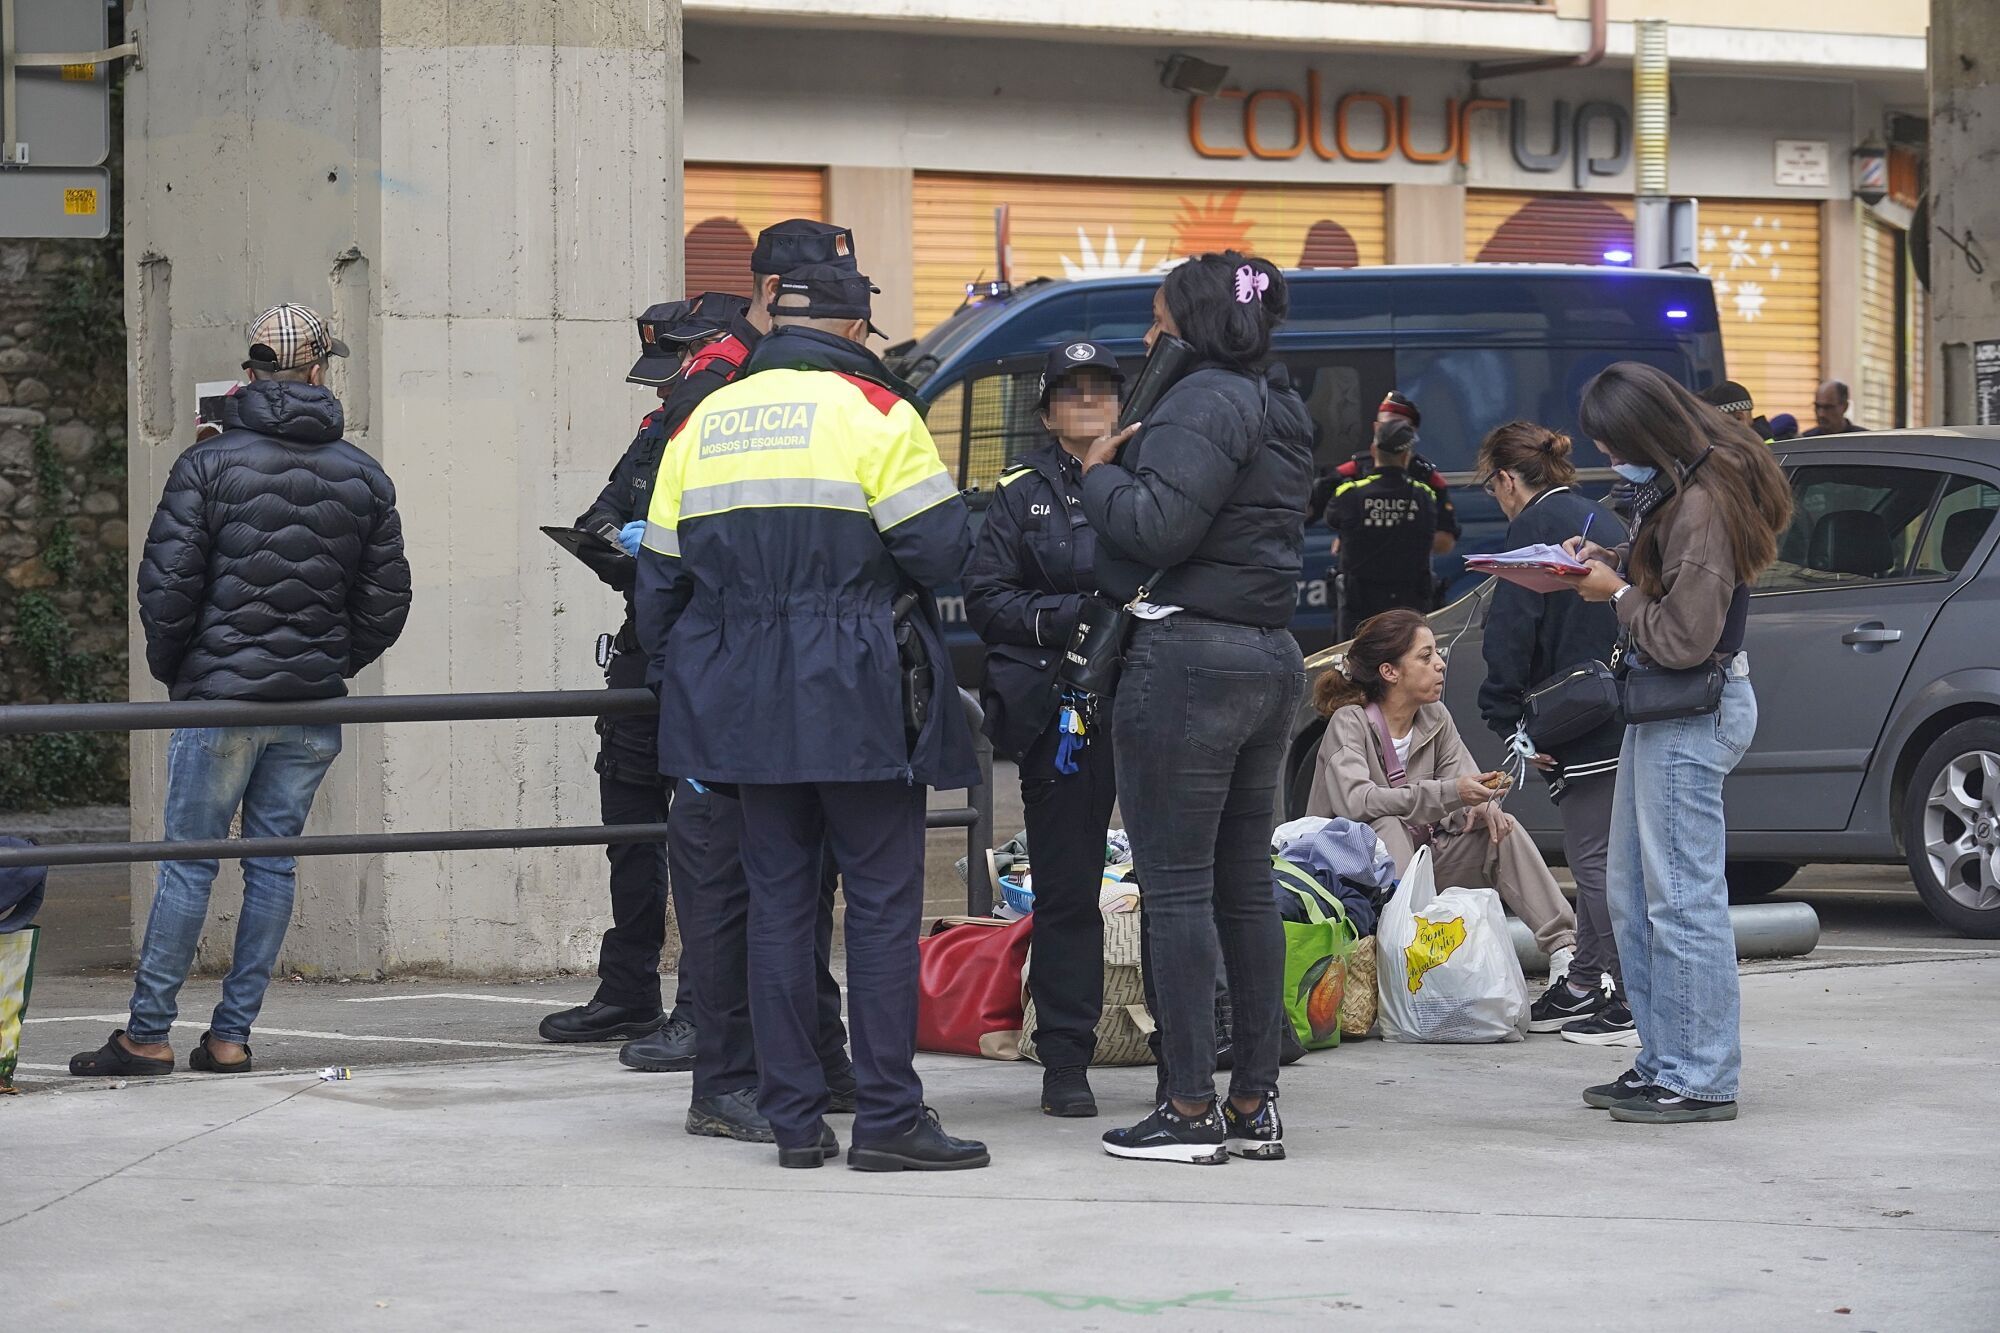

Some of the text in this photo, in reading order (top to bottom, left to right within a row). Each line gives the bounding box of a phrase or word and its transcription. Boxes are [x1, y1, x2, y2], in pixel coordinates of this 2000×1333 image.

[704, 406, 808, 439] POLICIA
[702, 441, 740, 456] MOSSOS
[1364, 498, 1420, 512] POLICA
